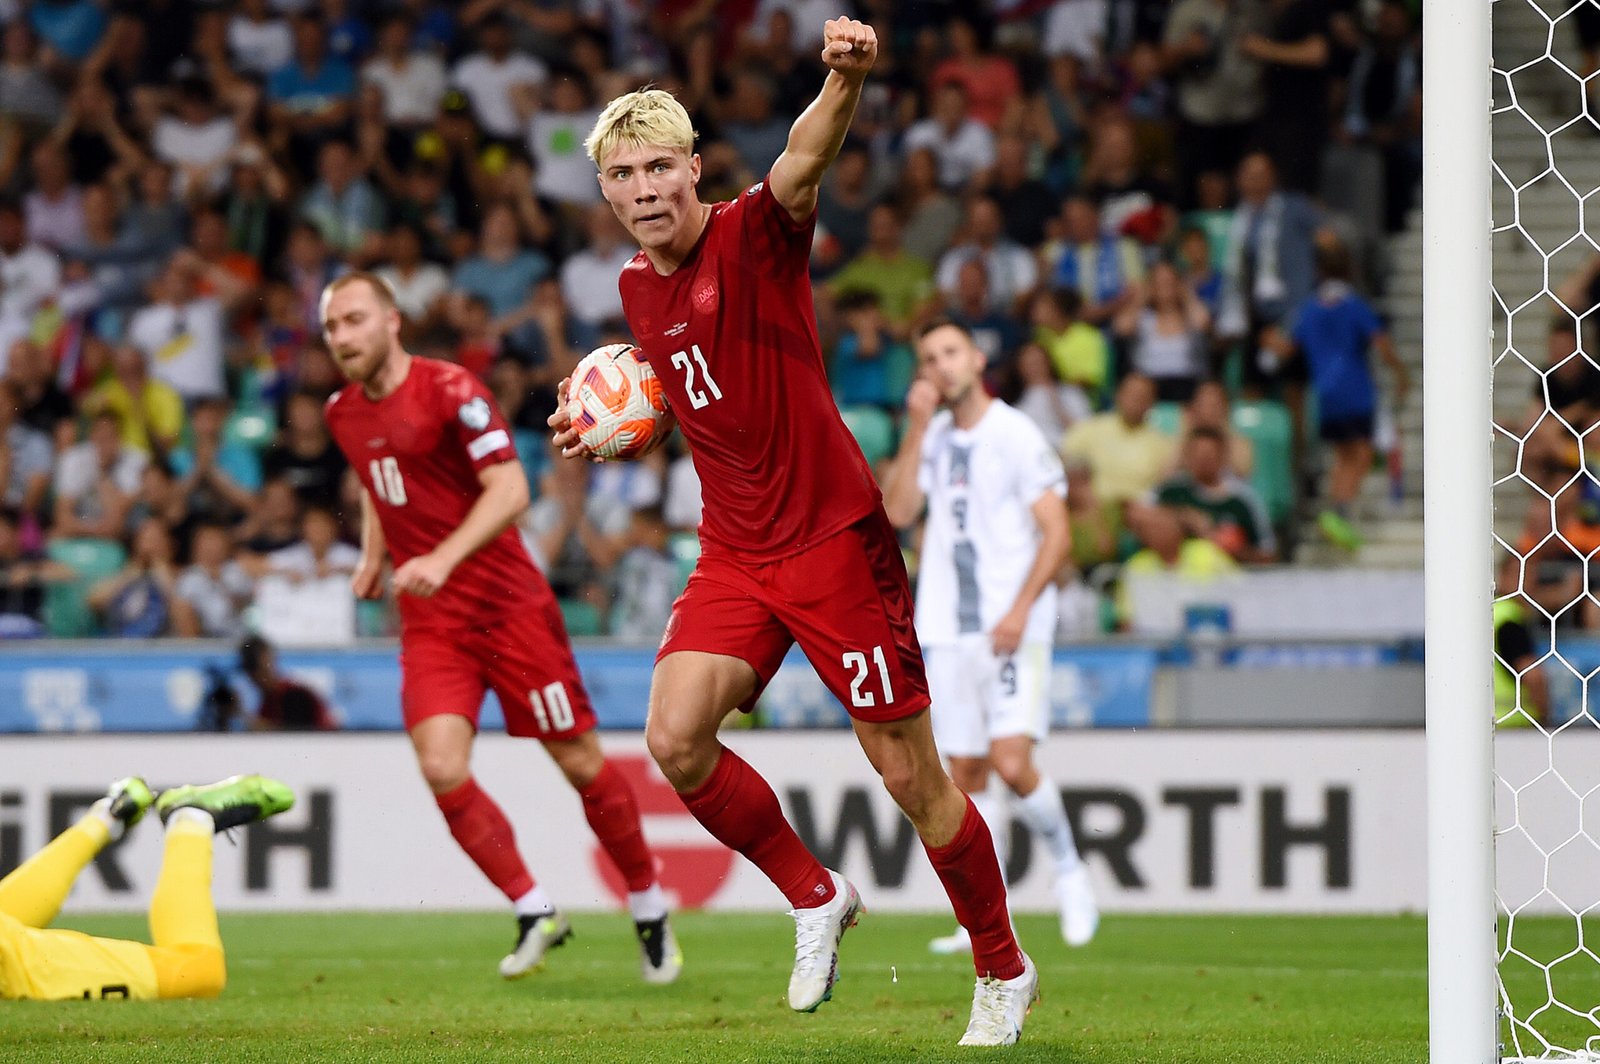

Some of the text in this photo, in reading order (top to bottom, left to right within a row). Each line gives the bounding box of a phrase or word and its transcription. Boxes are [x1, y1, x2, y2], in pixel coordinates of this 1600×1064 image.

[670, 344, 723, 410] 21
[368, 456, 408, 506] 10
[528, 681, 576, 733] 10
[842, 645, 894, 707] 21
[784, 784, 1352, 890] WRTH
